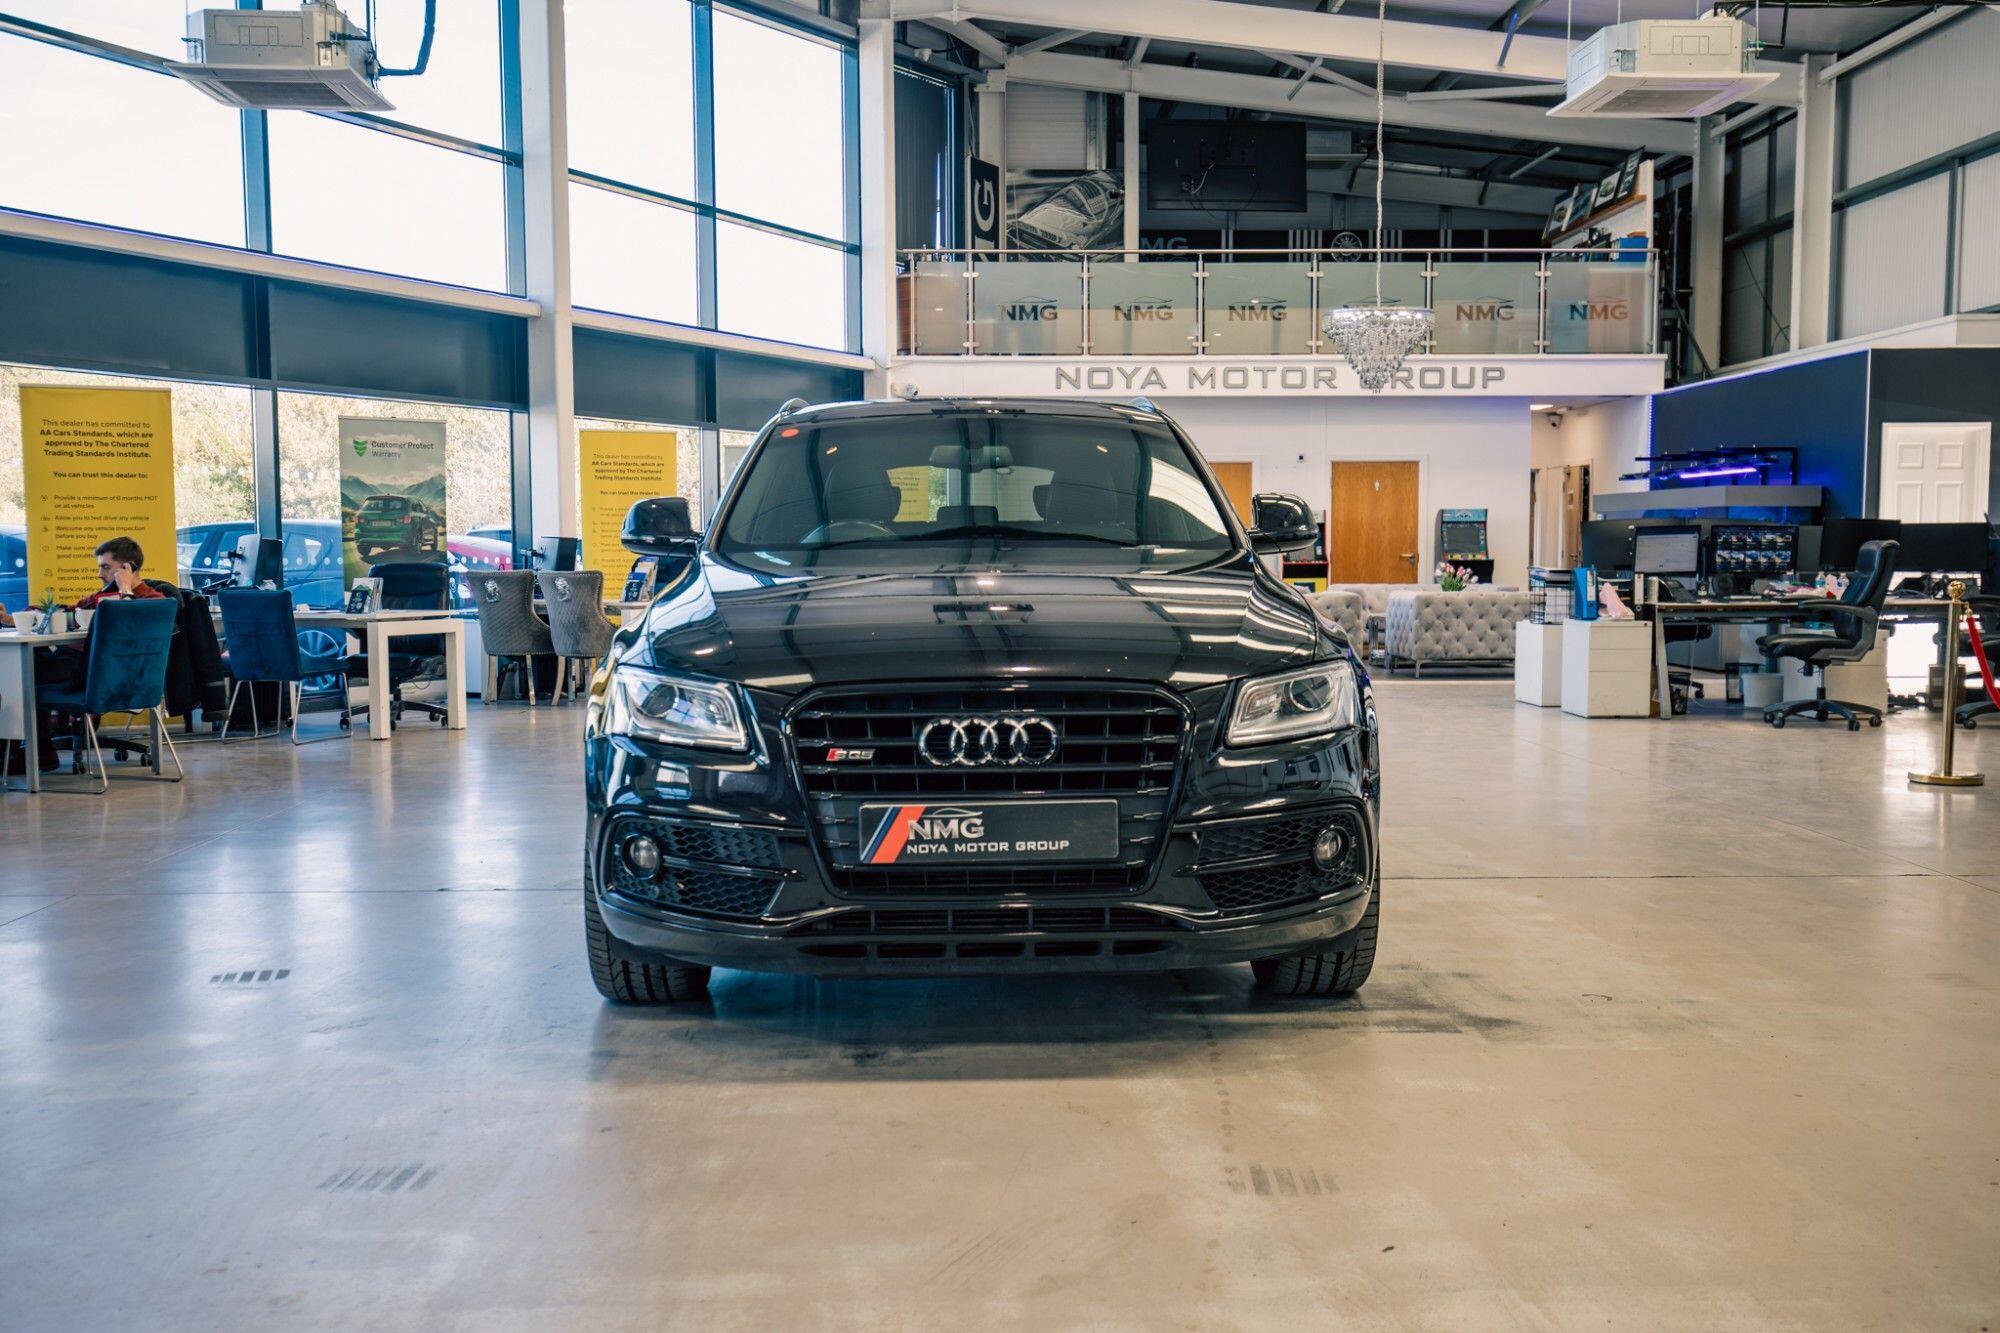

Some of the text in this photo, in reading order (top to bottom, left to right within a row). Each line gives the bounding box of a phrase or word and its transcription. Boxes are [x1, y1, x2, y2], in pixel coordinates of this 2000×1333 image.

[999, 304, 1058, 321] NMG
[1113, 304, 1174, 321] NMG
[1228, 305, 1288, 321] NMG
[1456, 304, 1515, 321] NMG
[1570, 304, 1629, 320] NMG
[1055, 366, 1168, 390] NOYA
[1188, 366, 1338, 390] MOTOR
[371, 440, 406, 449] Customer
[835, 750, 875, 760] SQ5
[908, 818, 984, 840] NMG
[907, 840, 1070, 854] NOYA MOTOR GROUP
